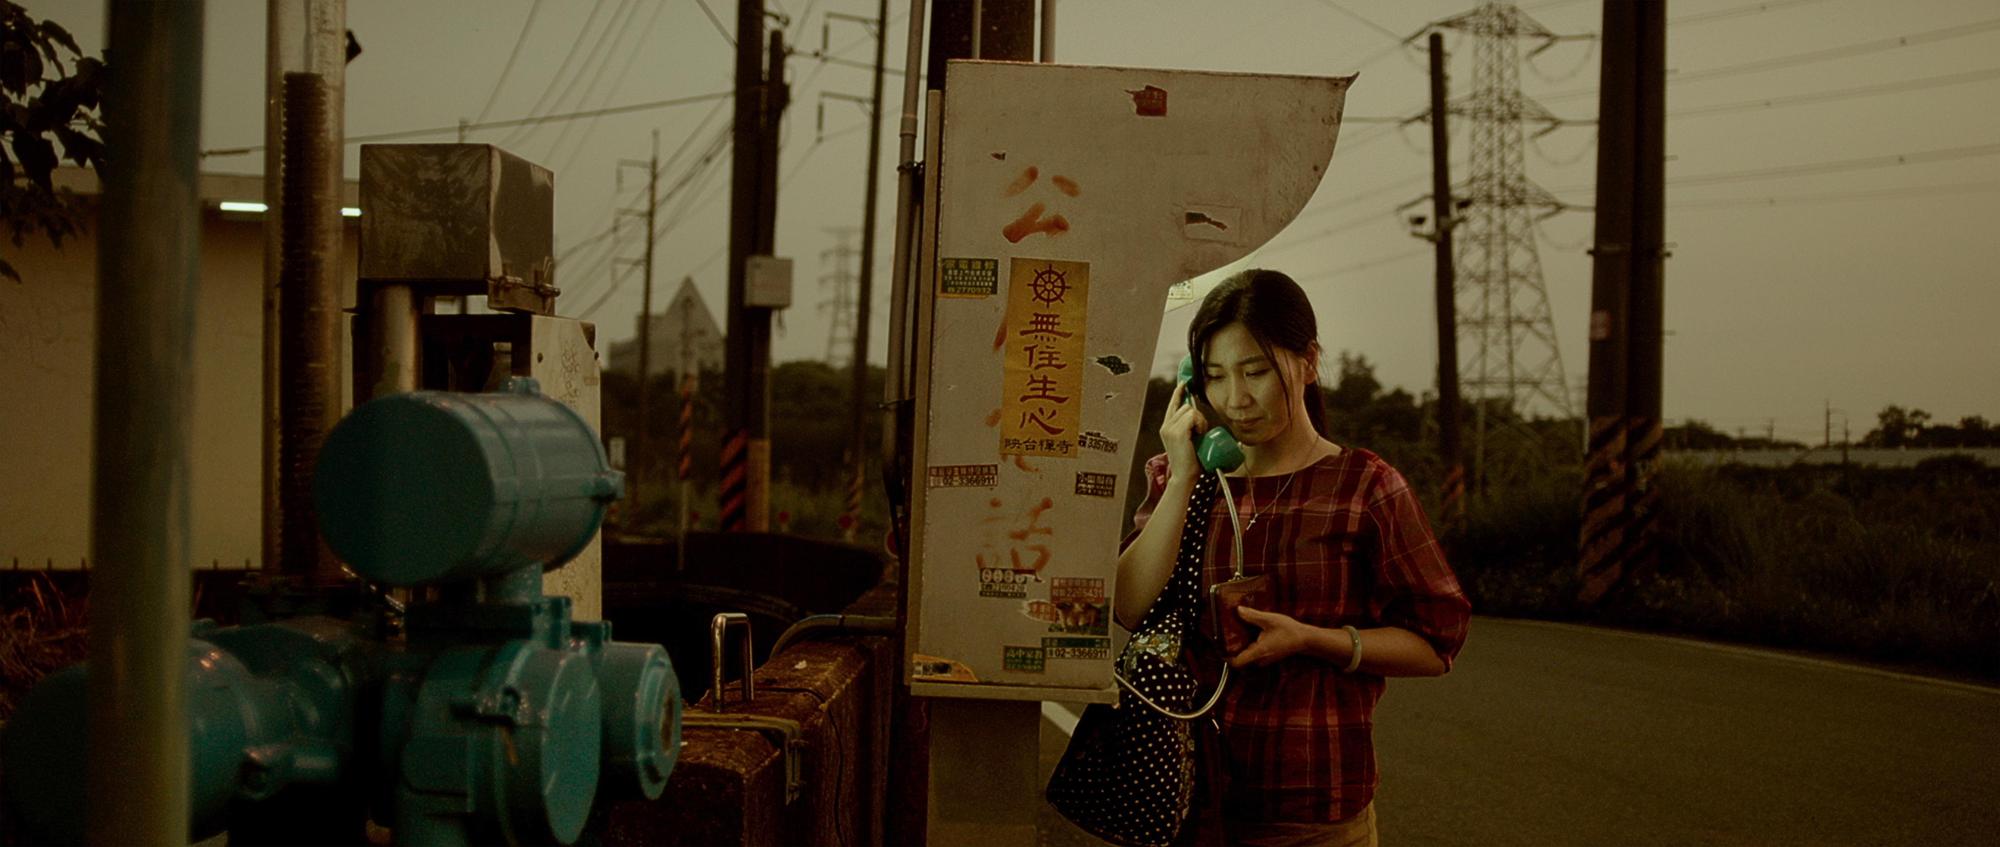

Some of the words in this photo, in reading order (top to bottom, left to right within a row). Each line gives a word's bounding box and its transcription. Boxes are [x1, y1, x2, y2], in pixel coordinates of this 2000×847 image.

[1018, 313, 1072, 436] 無住生心
[1054, 648, 1107, 658] 02-3366911
